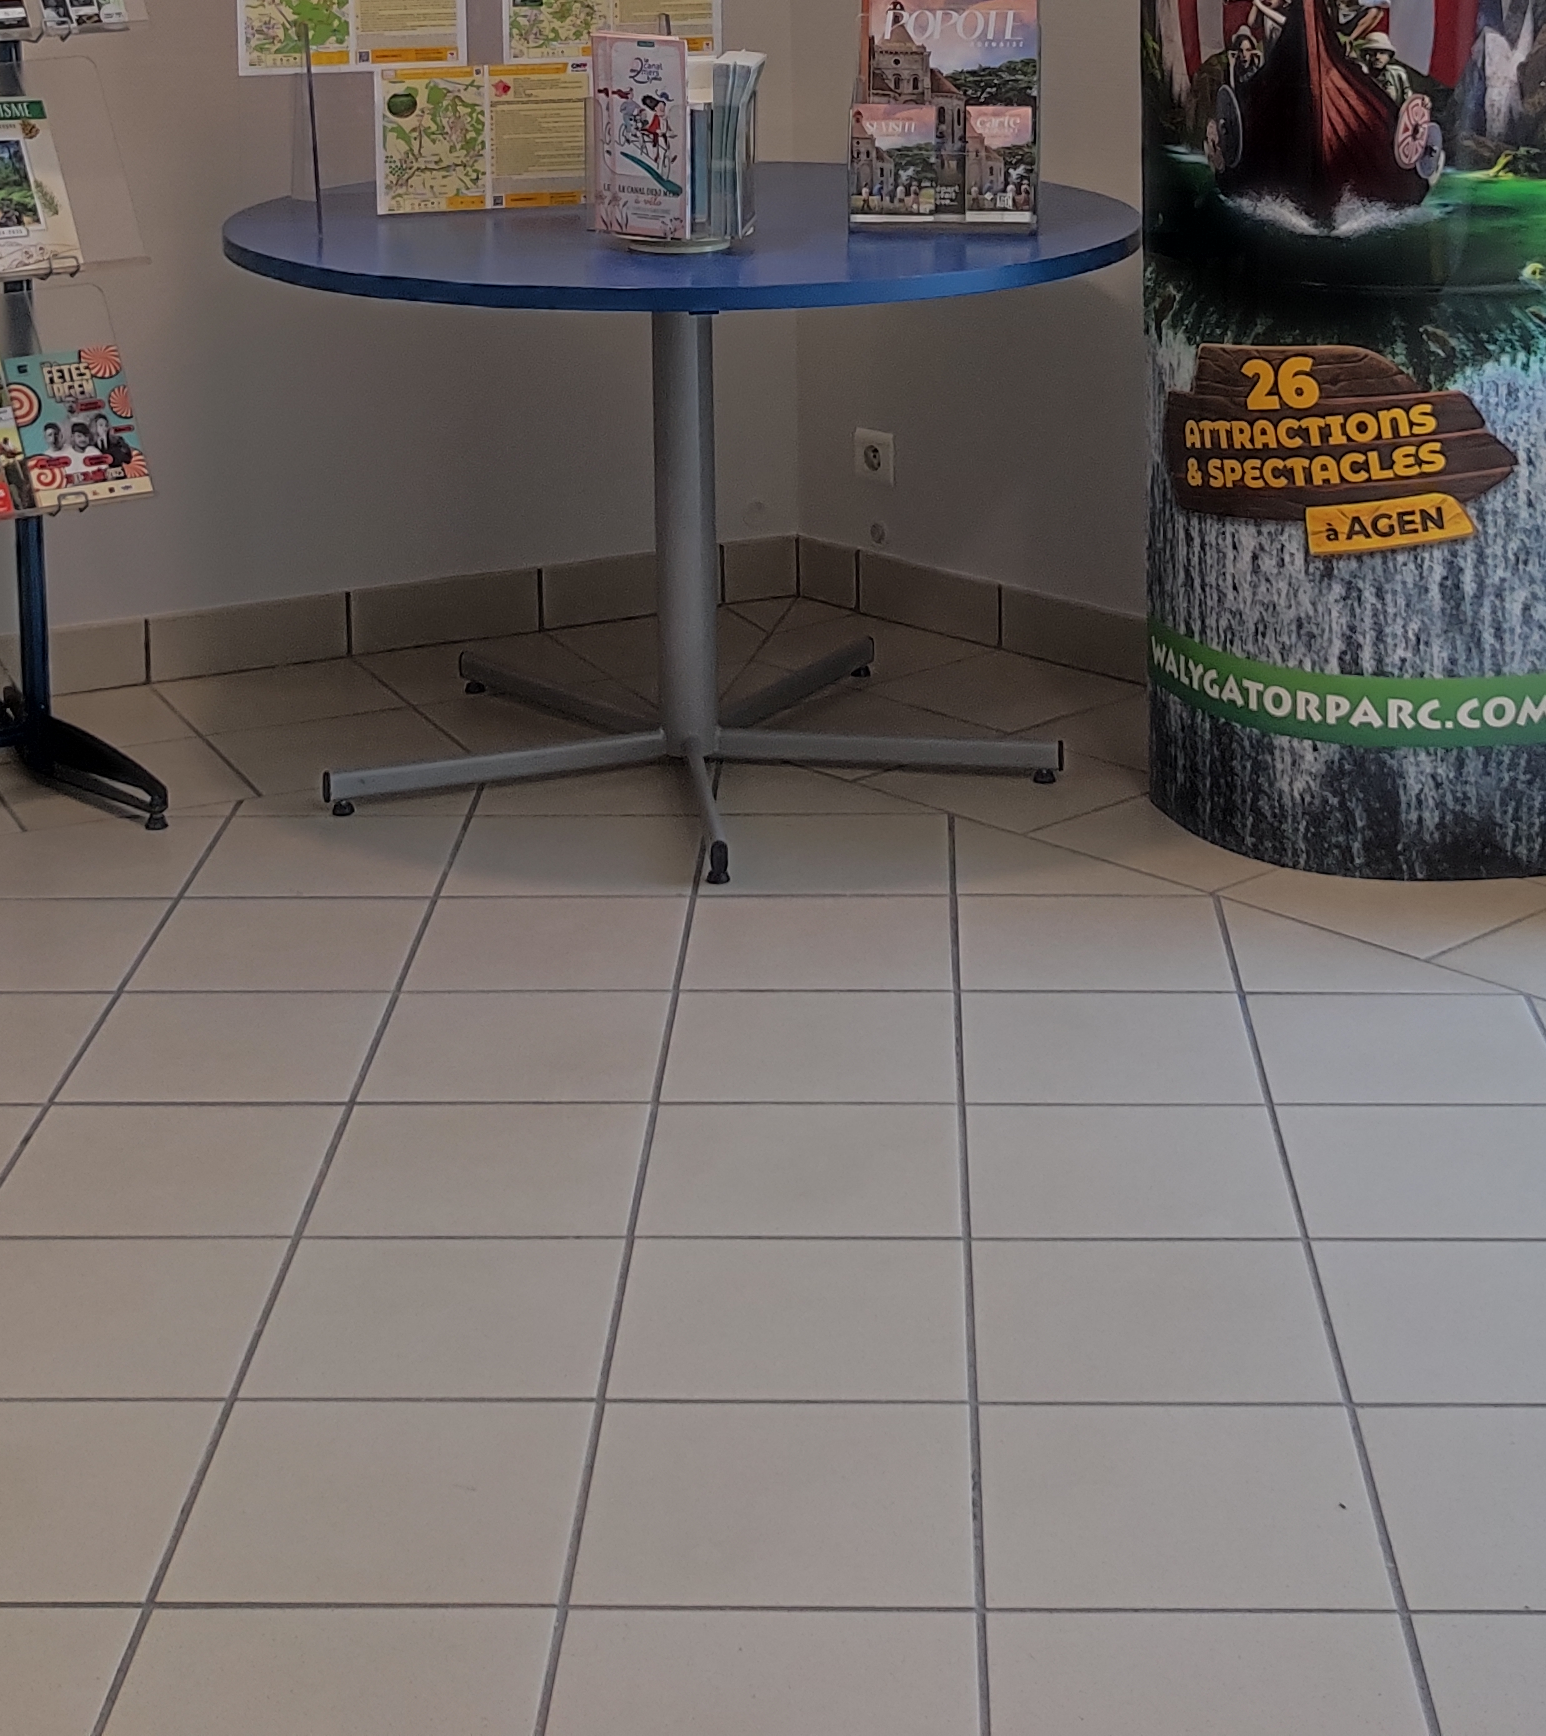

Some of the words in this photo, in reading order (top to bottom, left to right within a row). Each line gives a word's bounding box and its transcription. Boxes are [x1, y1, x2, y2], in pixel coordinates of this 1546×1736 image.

[884, 10, 1024, 40] POPOTE
[1240, 356, 1321, 411] 26
[1184, 404, 1437, 451] ATTRACTIONS
[1186, 460, 1203, 488] &
[1207, 442, 1446, 489] SPECTACLES
[1325, 522, 1339, 543] à
[1347, 506, 1445, 540] AGEN
